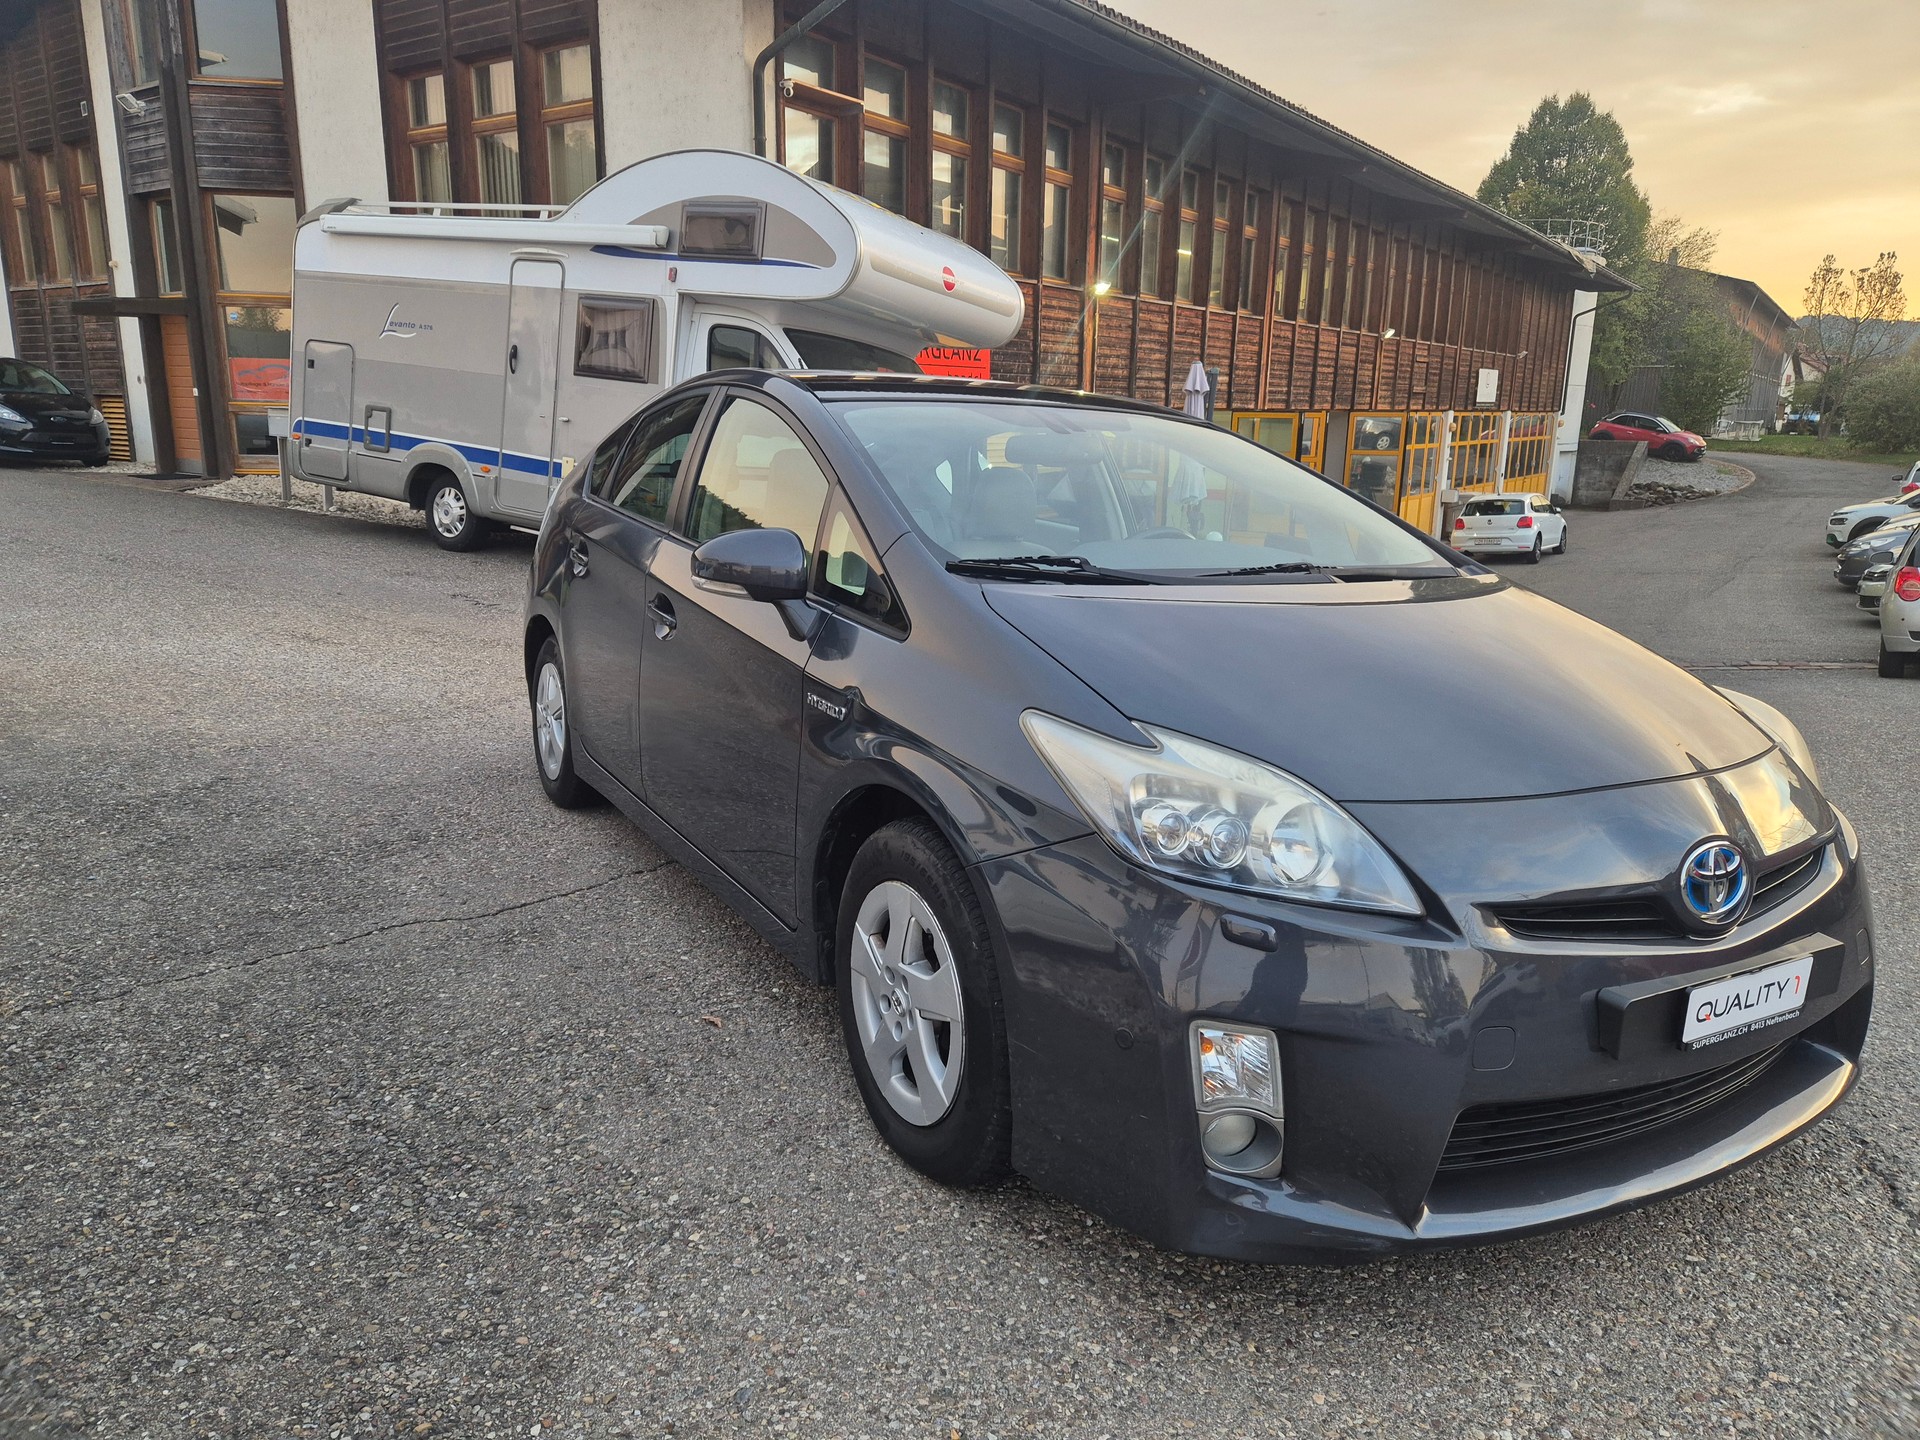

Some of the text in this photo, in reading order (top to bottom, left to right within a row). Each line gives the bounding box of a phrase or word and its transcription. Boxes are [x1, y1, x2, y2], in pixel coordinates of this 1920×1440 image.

[807, 692, 846, 721] HYBRID
[1696, 975, 1801, 1023] QUALITY 1
[1692, 1010, 1800, 1050] SUPERGLANZ.CH 8413 Neftenbach
